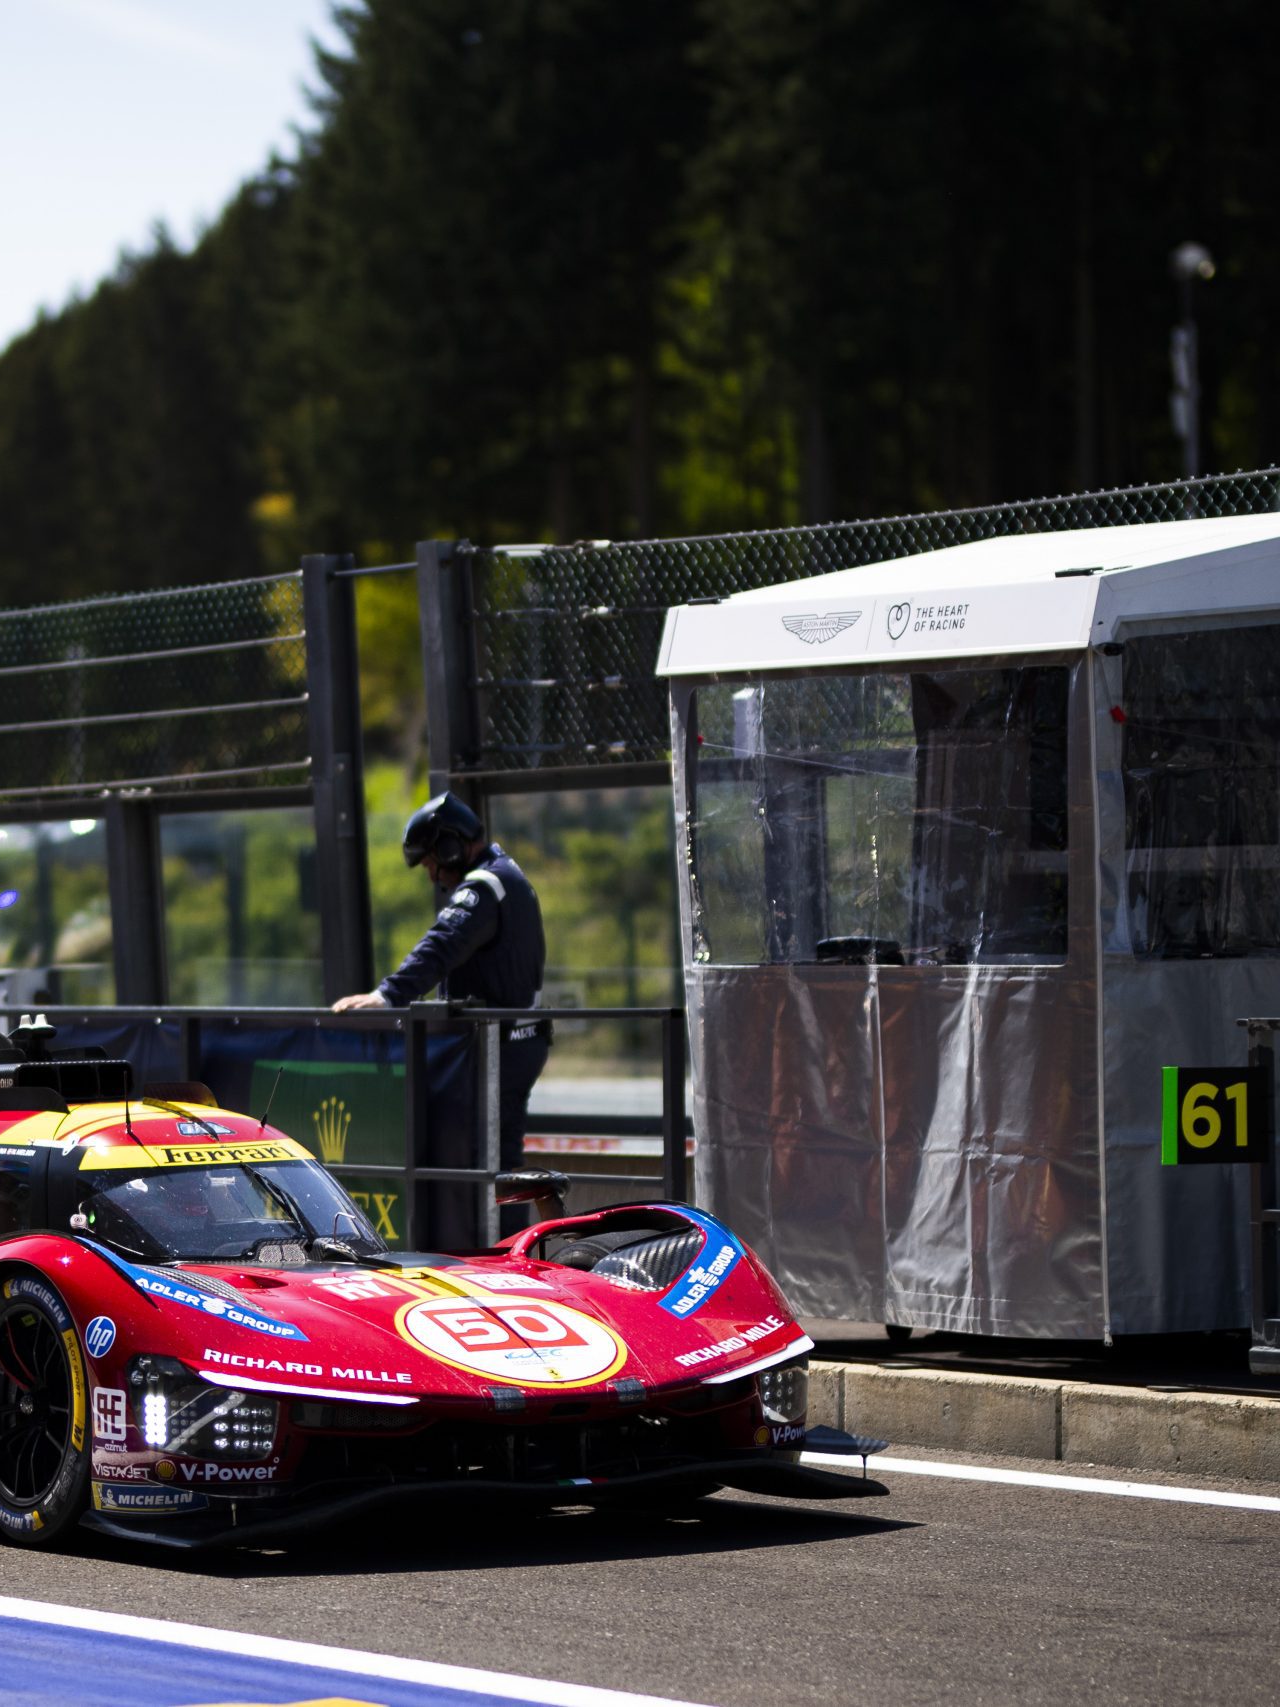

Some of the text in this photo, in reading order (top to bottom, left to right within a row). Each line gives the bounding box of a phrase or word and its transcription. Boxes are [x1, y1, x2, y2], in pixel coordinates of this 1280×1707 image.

[914, 618, 966, 632] OF RACING
[915, 604, 970, 619] THE HEART
[1181, 1082, 1248, 1149] 61
[161, 1143, 298, 1164] Ferrari
[672, 1245, 737, 1314] ADLER GROUP
[20, 1279, 66, 1323] MICHELIN
[135, 1277, 295, 1336] ADLER GROUP
[86, 1316, 116, 1358] hp
[433, 1308, 568, 1346] 50
[674, 1315, 785, 1367] RICHARD MILLE
[66, 1336, 81, 1398] PILOT SPORT
[204, 1348, 413, 1384] RICHARD MILLE
[180, 1463, 277, 1481] V-Power
[118, 1493, 193, 1506] MICHELIN
